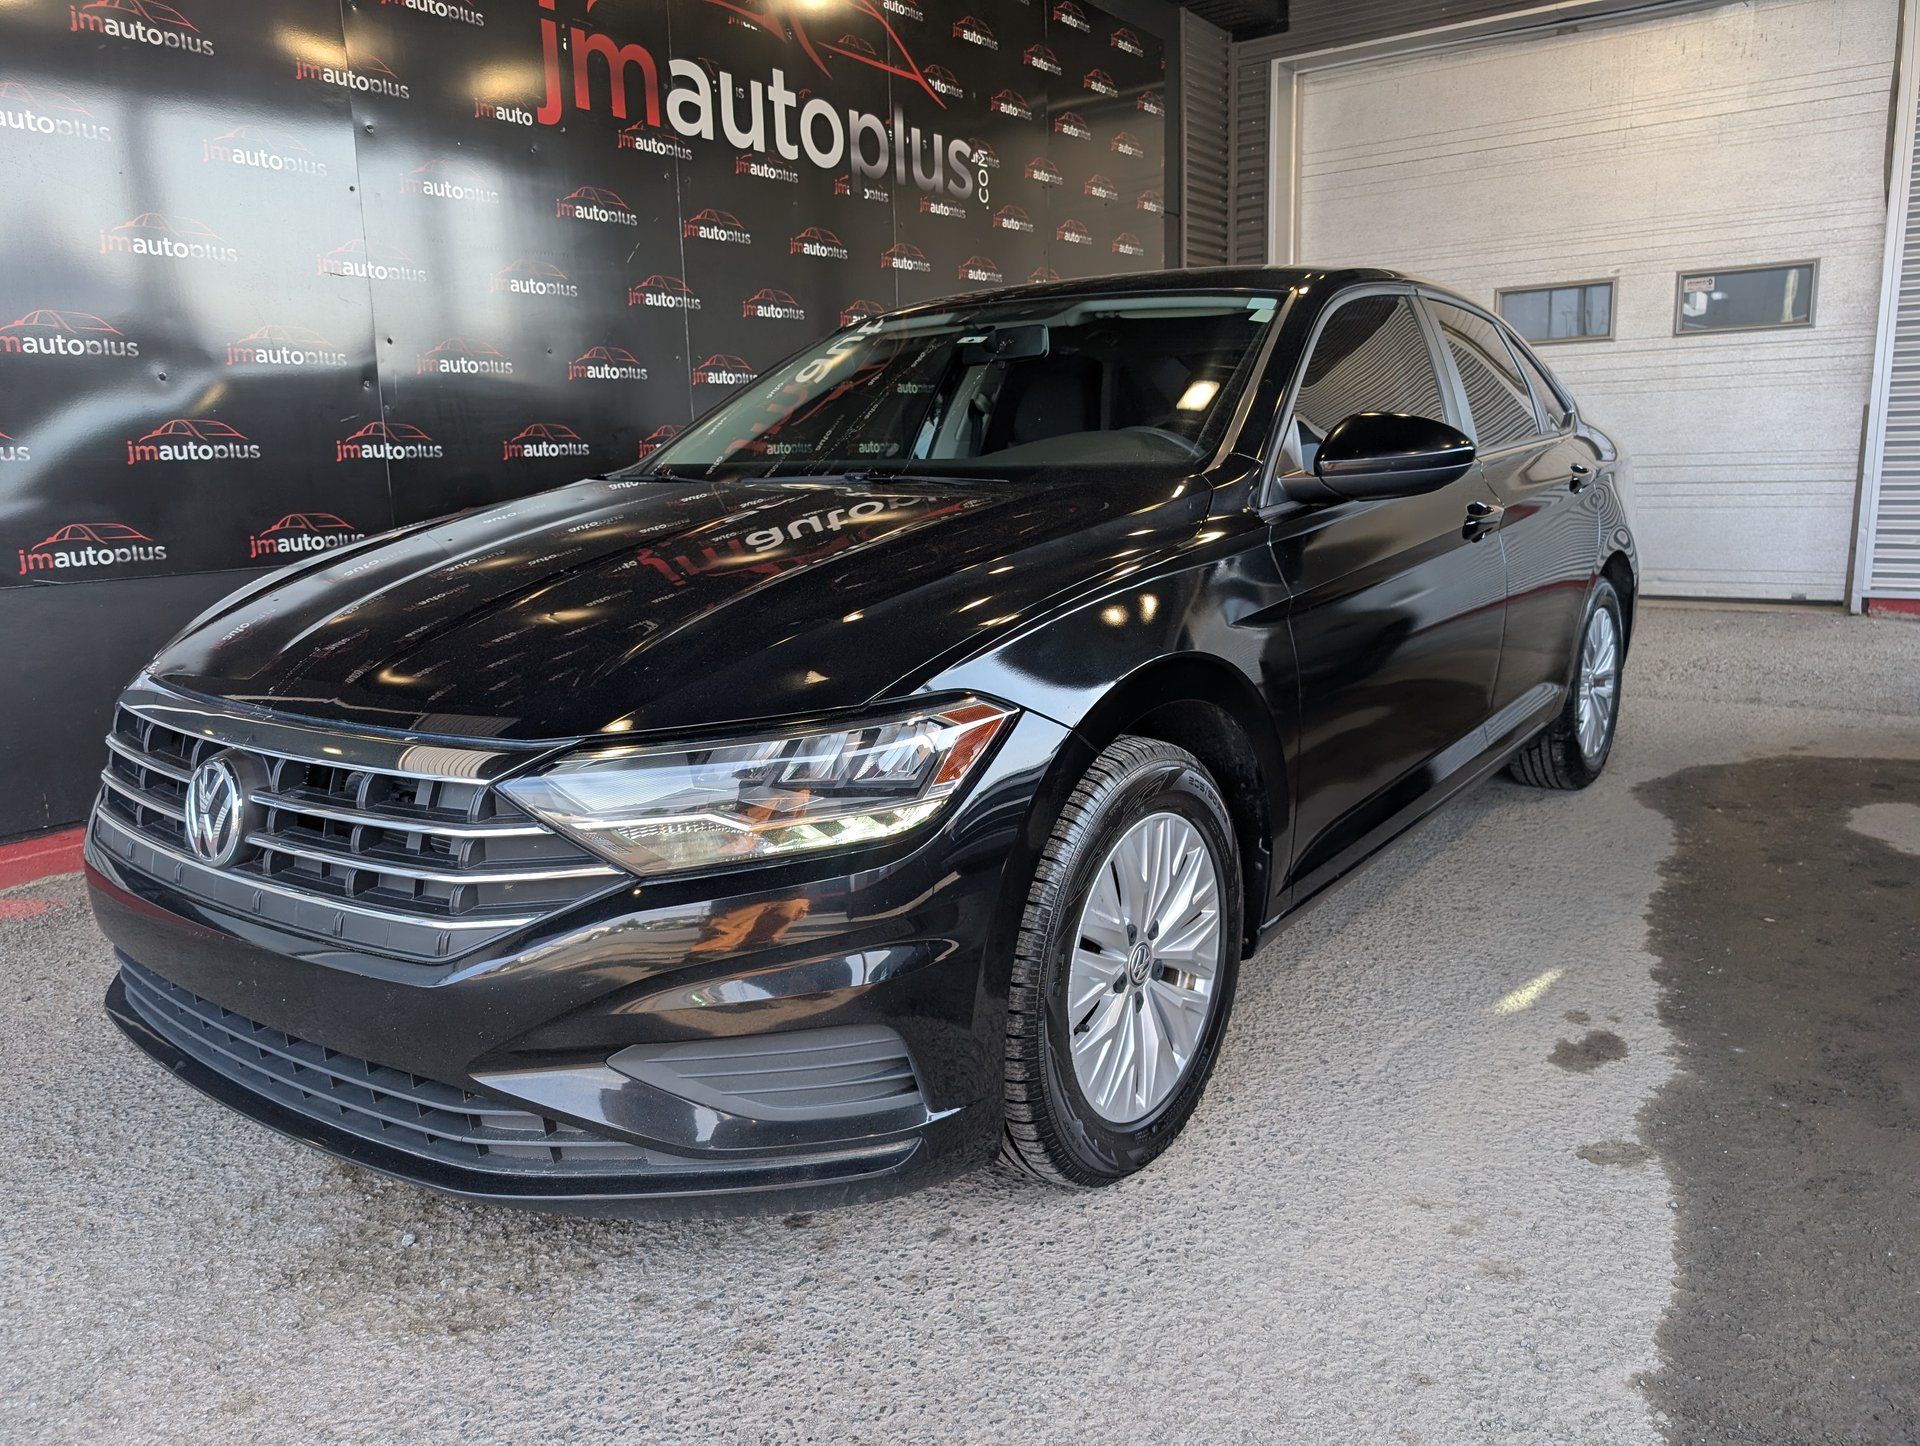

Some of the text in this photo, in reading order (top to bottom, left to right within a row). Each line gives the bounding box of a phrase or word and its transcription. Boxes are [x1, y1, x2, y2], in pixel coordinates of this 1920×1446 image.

[70, 5, 215, 56] jmautoplus
[295, 57, 410, 100] jmautoplus
[474, 98, 533, 126] jmauto
[536, 0, 973, 200] jmautoplus
[202, 138, 327, 177] jmautoplus
[617, 130, 692, 161] jmautoplus
[735, 156, 799, 184] jmautoplus
[400, 173, 499, 204] jmautoplus
[556, 199, 637, 226] jmautoplus
[683, 220, 751, 245] jmautoplus
[100, 229, 238, 263] jmautoplus
[790, 237, 848, 260] jmautoplus
[316, 254, 428, 284] jmautoplus
[490, 273, 578, 297] jmautoplus
[628, 288, 701, 310] jmautoplus
[743, 301, 805, 320] jmautoplus
[0, 334, 140, 357] mautoplus
[226, 343, 347, 367] jmautoplus
[416, 354, 514, 375] jmautoplus
[568, 362, 648, 380] jmautoplus
[127, 440, 261, 465] jmautoplus
[336, 440, 443, 462] jmautoplus
[503, 440, 590, 461] jmautoplus
[18, 544, 167, 575] jmautoplus
